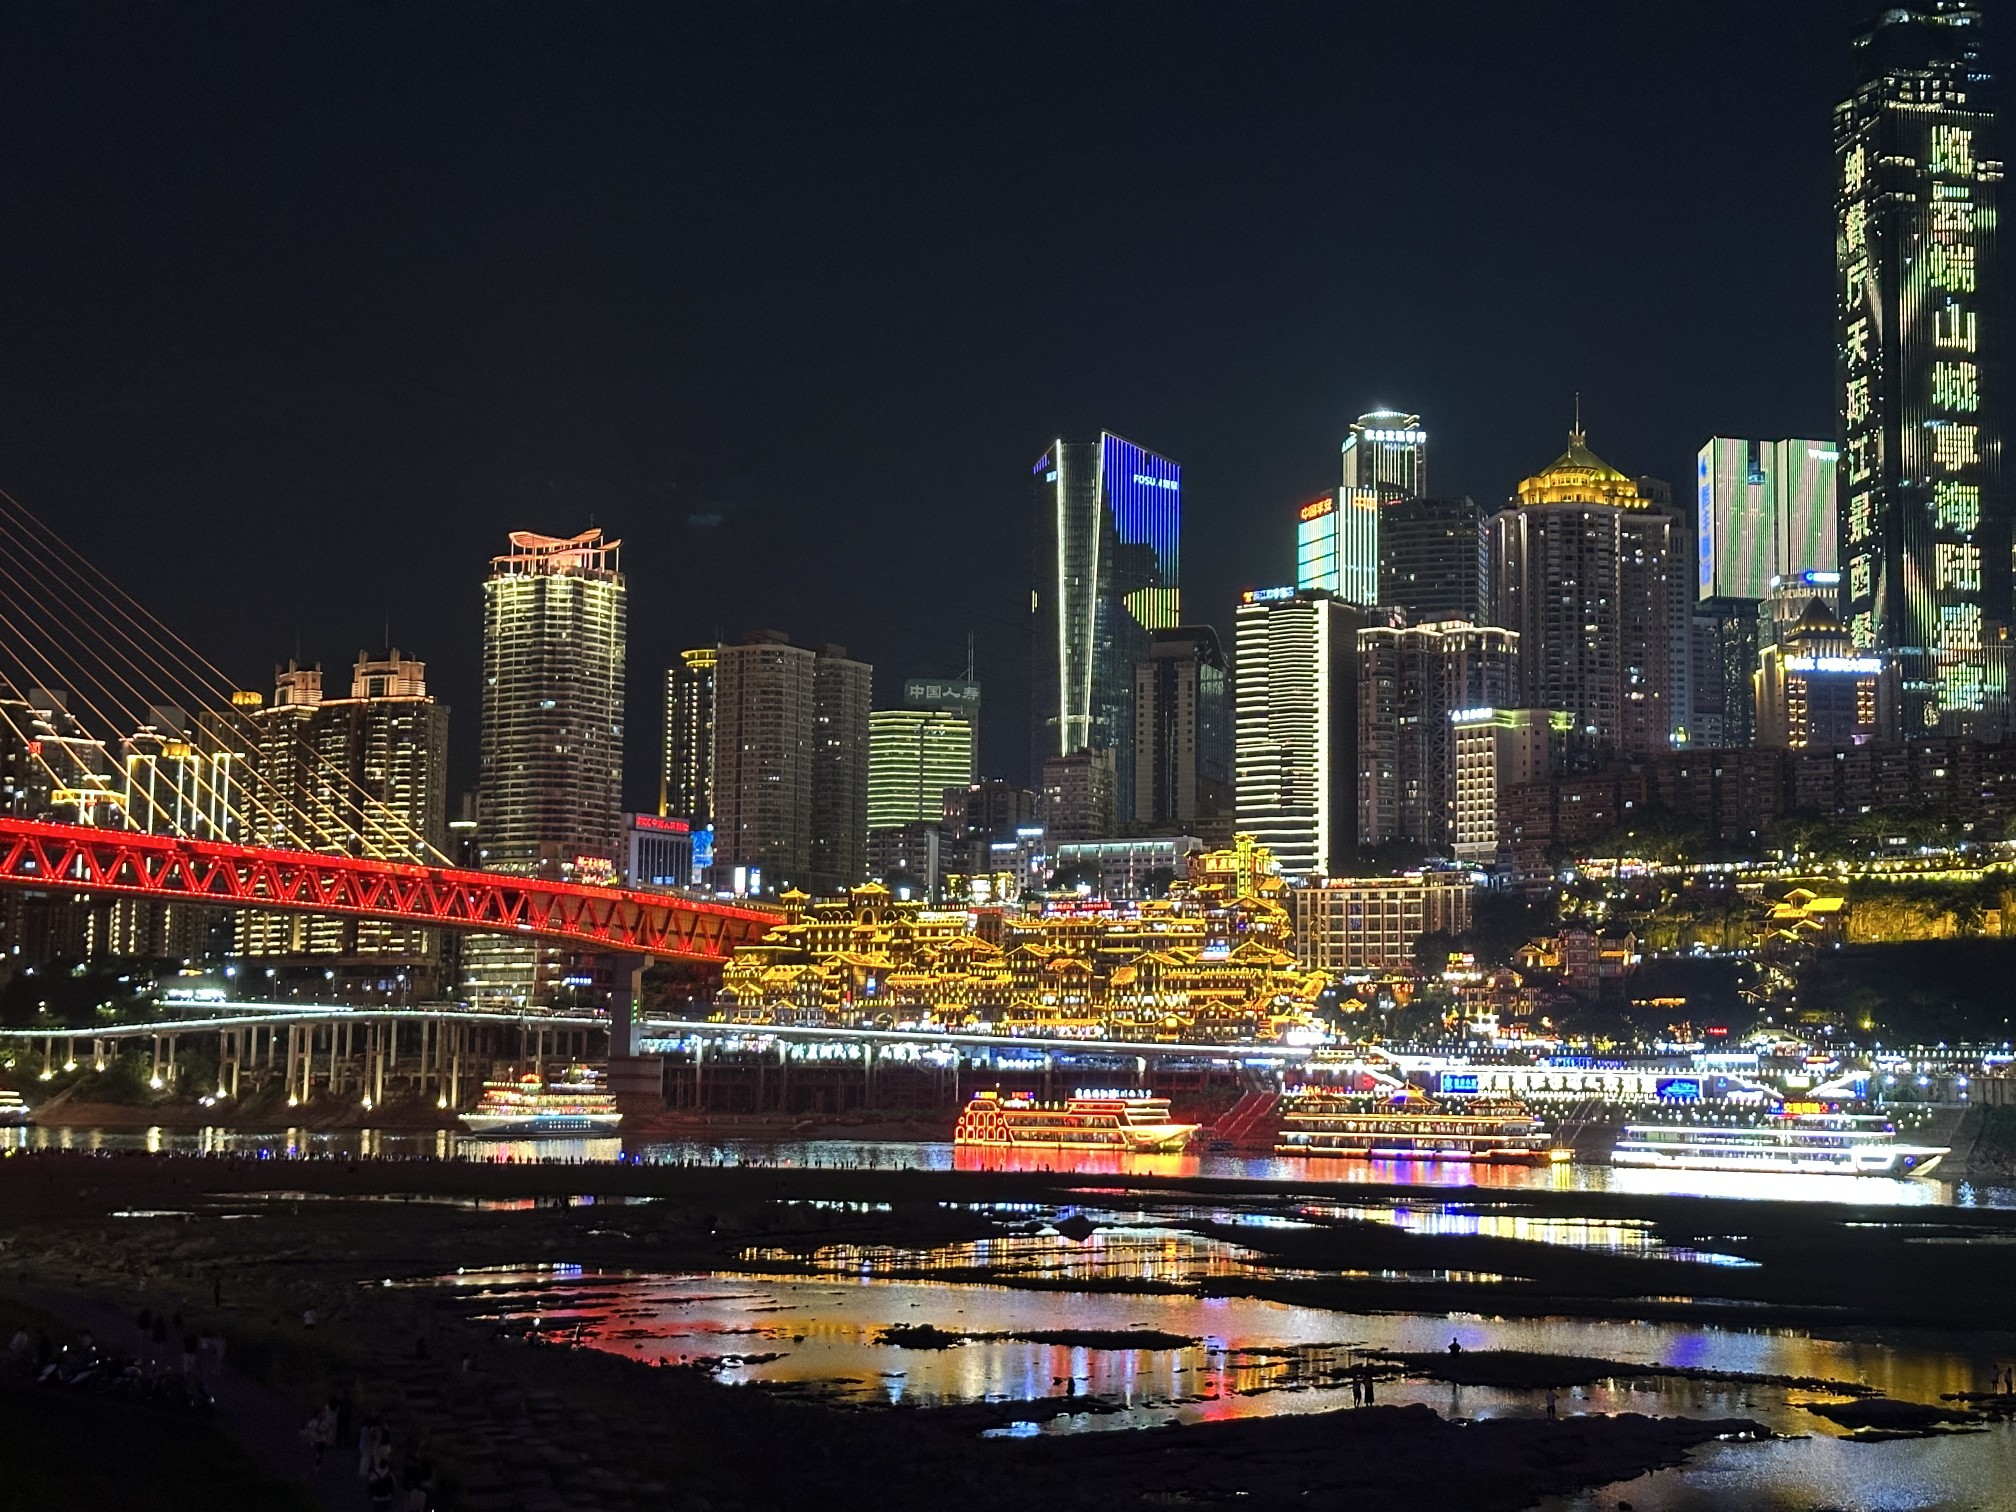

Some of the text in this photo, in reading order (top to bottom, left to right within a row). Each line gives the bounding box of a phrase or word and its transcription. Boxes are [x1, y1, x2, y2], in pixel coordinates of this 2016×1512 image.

[1301, 498, 1333, 520] 中国平安
[909, 684, 979, 701] 中国人寿
